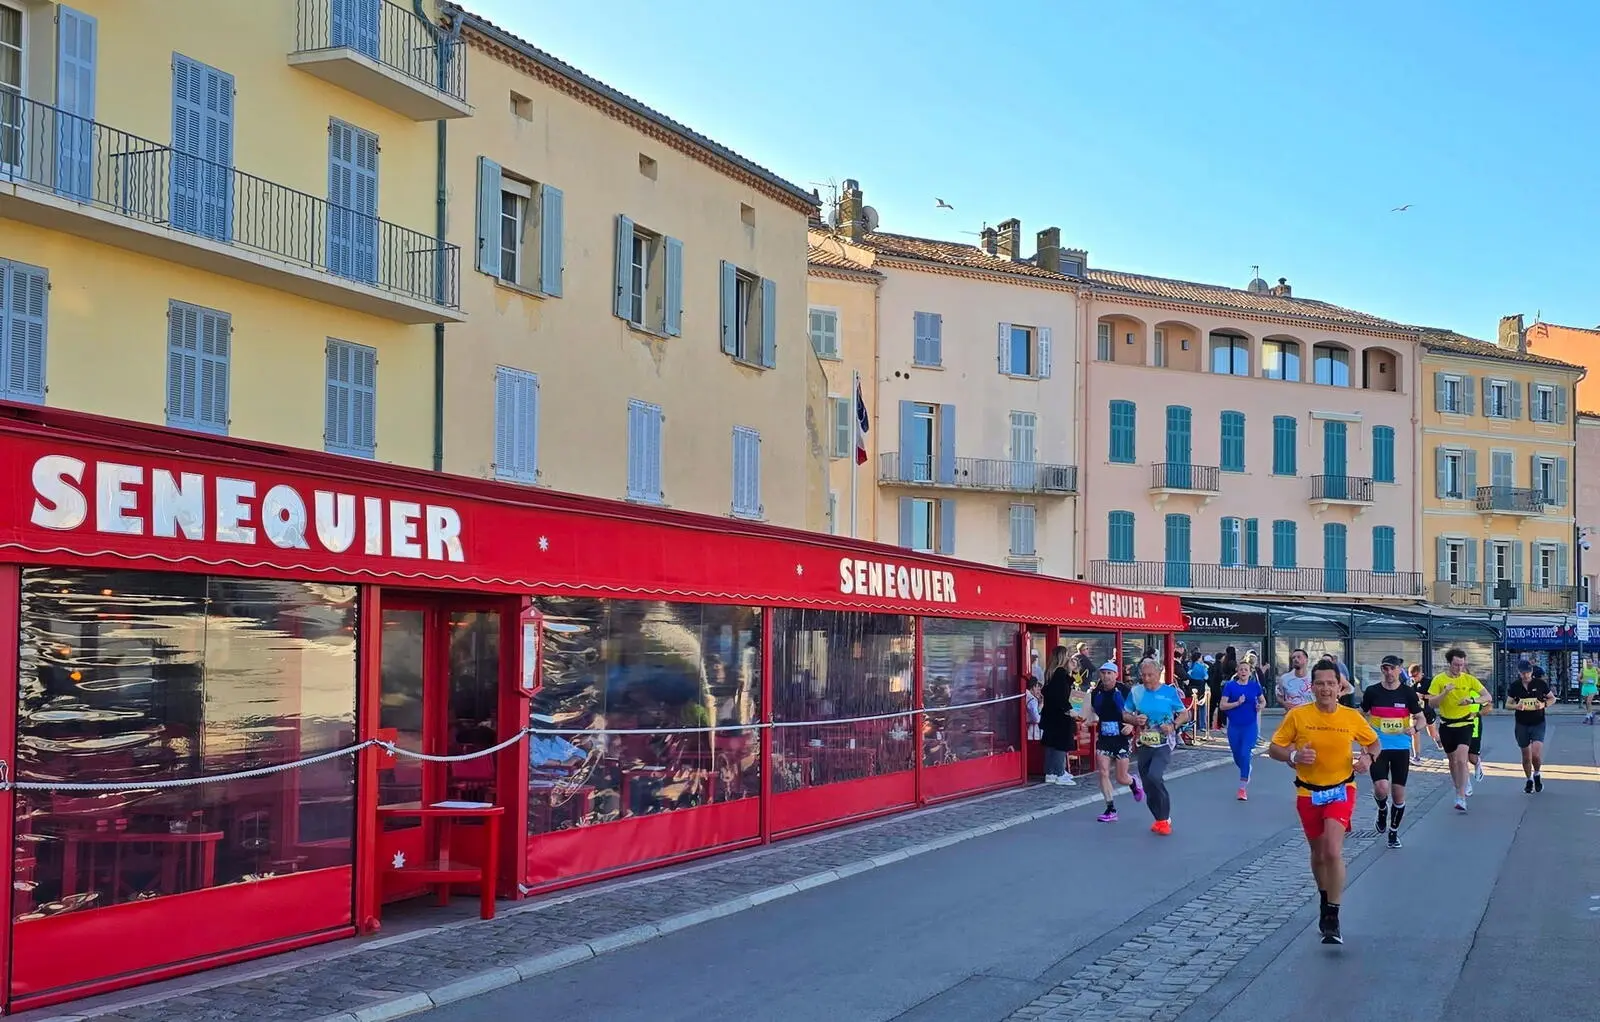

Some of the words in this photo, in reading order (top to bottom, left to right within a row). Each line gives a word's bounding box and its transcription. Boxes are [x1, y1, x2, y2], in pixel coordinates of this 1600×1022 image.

[30, 454, 465, 563] SENEQUIER
[839, 557, 957, 603] SENEQUIER
[1089, 591, 1146, 619] SENEQUIER
